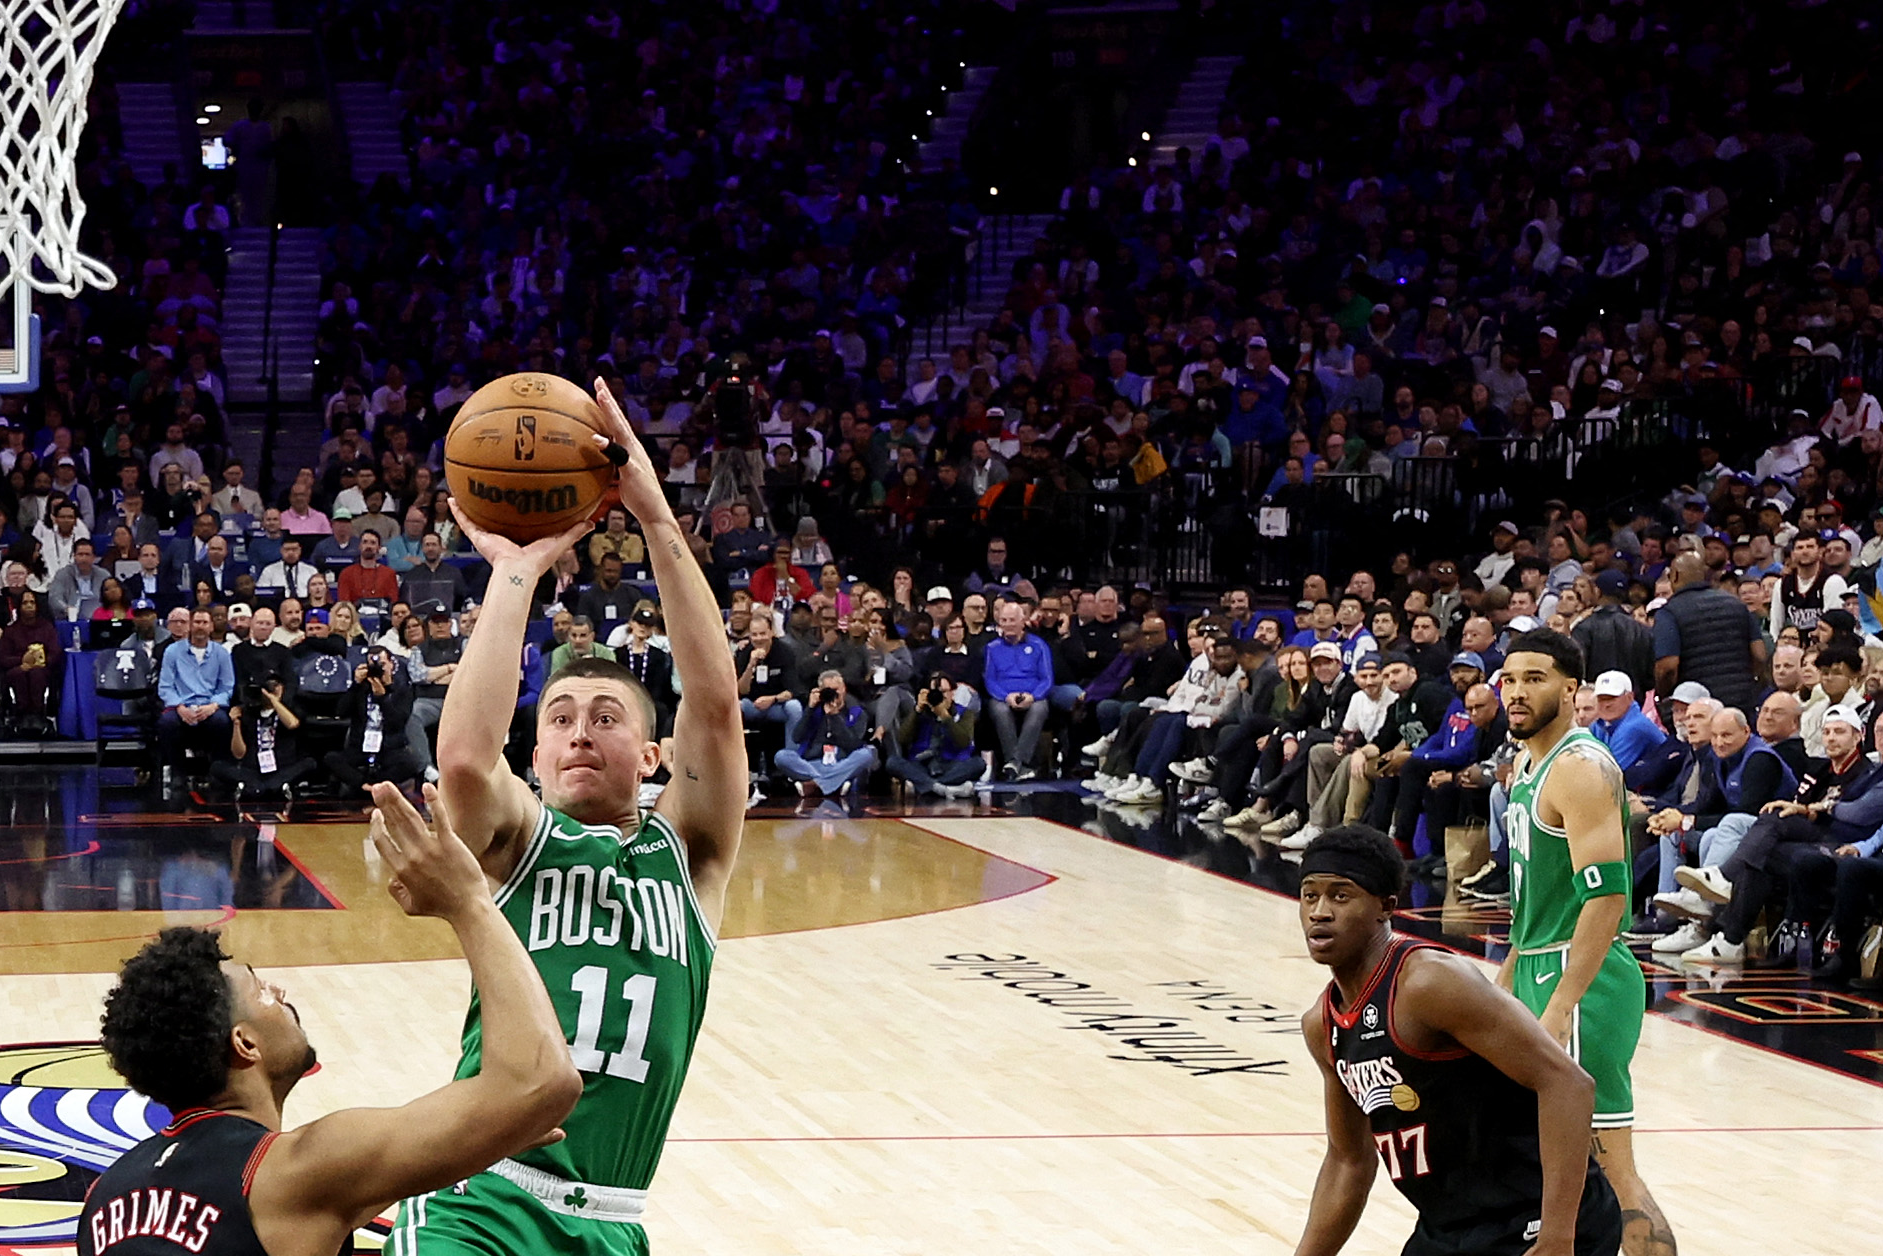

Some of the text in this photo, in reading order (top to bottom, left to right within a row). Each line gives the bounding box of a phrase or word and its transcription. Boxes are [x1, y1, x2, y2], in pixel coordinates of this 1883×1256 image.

[468, 477, 578, 514] Wilson
[623, 838, 668, 862] mica
[1583, 865, 1604, 889] 0
[528, 864, 688, 967] BOSTON
[929, 952, 1134, 1007] mobile
[566, 965, 658, 1084] 11
[1372, 1122, 1432, 1182] 77
